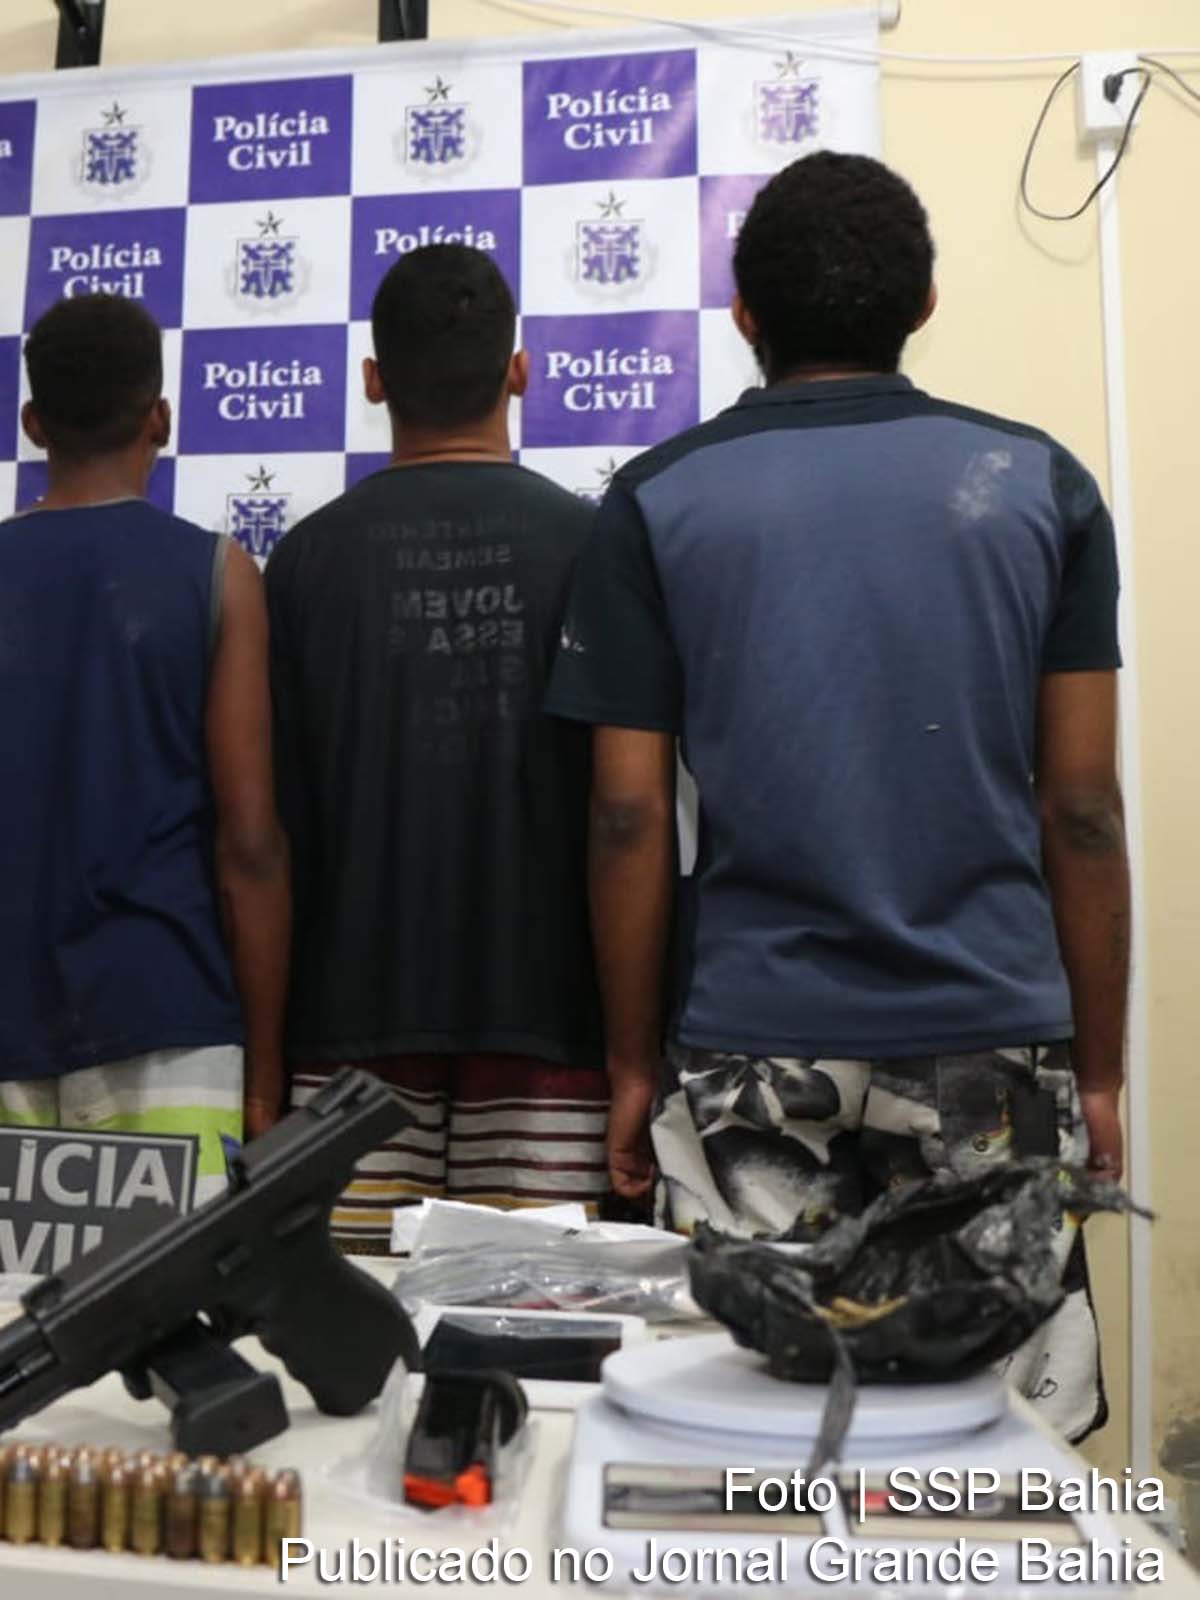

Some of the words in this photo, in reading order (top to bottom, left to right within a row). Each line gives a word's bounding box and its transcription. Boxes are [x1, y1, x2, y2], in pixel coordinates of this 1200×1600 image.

[546, 85, 673, 120] Polícia
[212, 109, 330, 142] Polícia
[563, 117, 653, 150] Civil
[227, 139, 312, 171] Civil
[49, 242, 162, 272] Polícia
[203, 359, 323, 390] Polícia
[545, 347, 675, 380] Polícia
[218, 391, 306, 421] Civil
[563, 381, 656, 412] Civil
